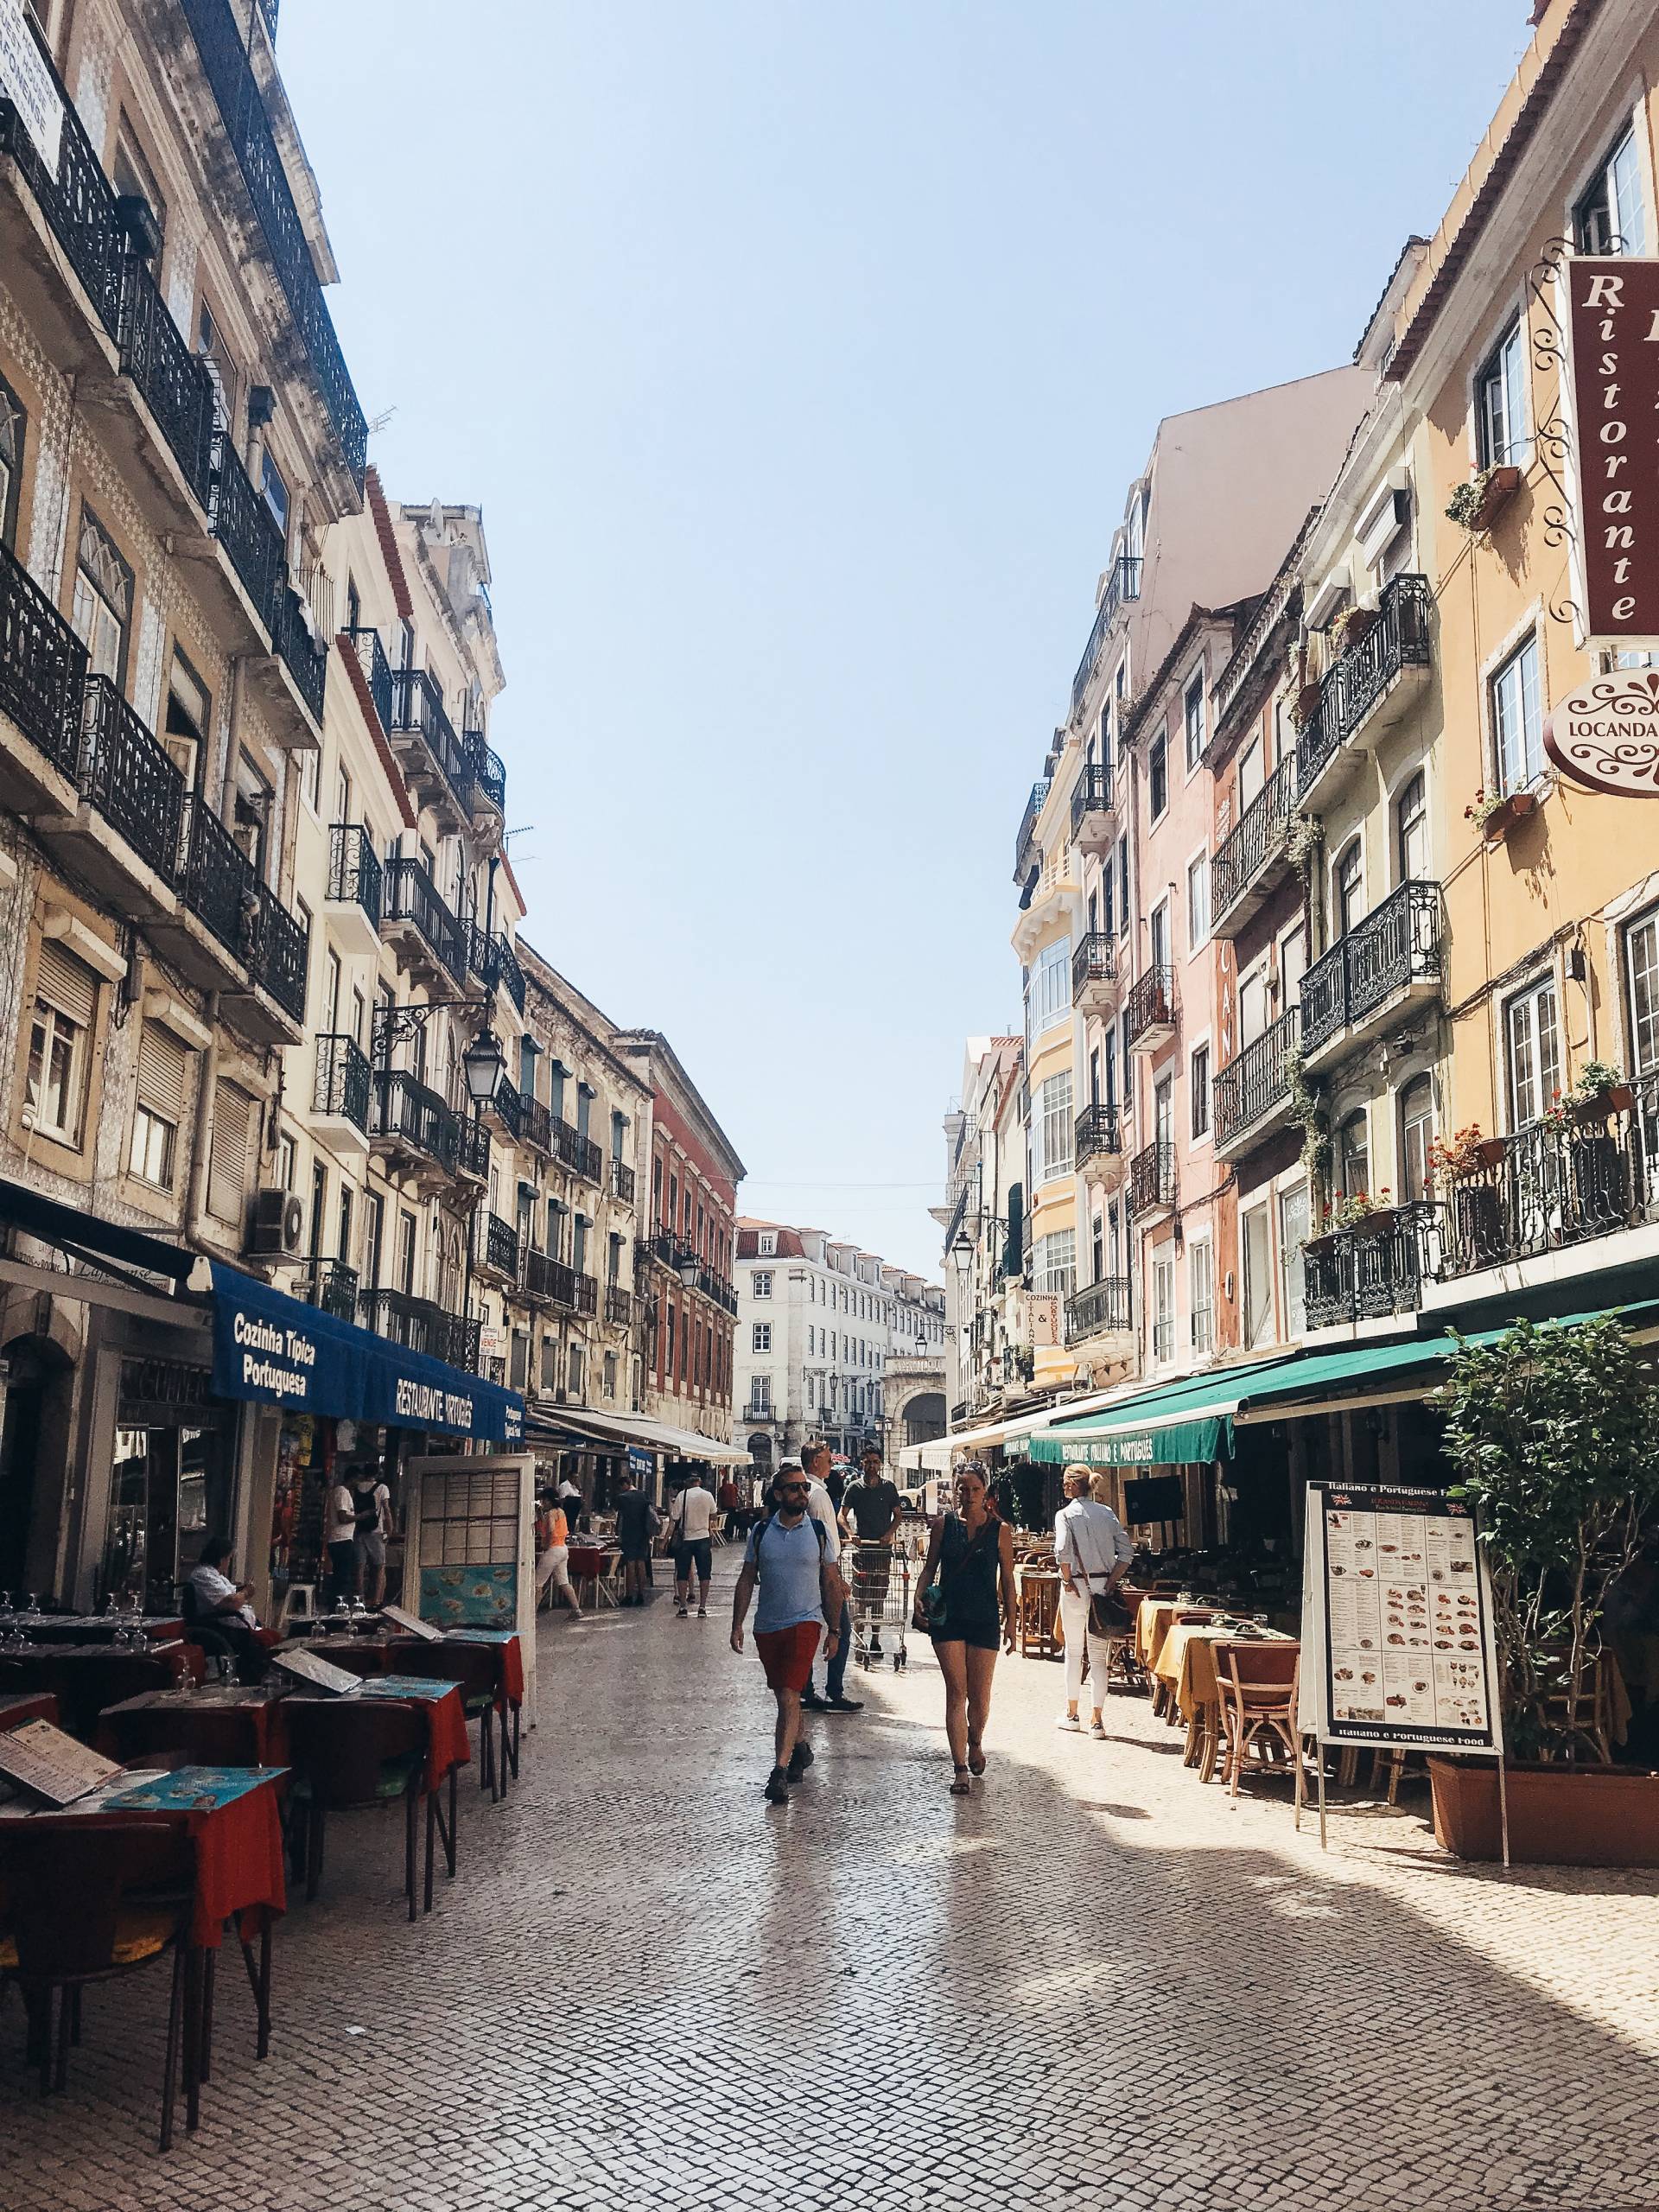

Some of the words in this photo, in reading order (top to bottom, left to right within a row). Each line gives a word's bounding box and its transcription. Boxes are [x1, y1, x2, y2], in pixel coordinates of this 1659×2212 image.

[0, 7, 22, 55] UEST
[22, 54, 47, 113] HOUSE
[1582, 275, 1636, 621] Ristorante
[1569, 721, 1658, 737] LOCANDA
[234, 1313, 283, 1355] Cozinha
[286, 1330, 315, 1367] Típica
[244, 1354, 306, 1398] Portuguesa
[1113, 1445, 1118, 1462] E
[1329, 1483, 1368, 1492] Italiano
[1380, 1485, 1438, 1496] Portuguese
